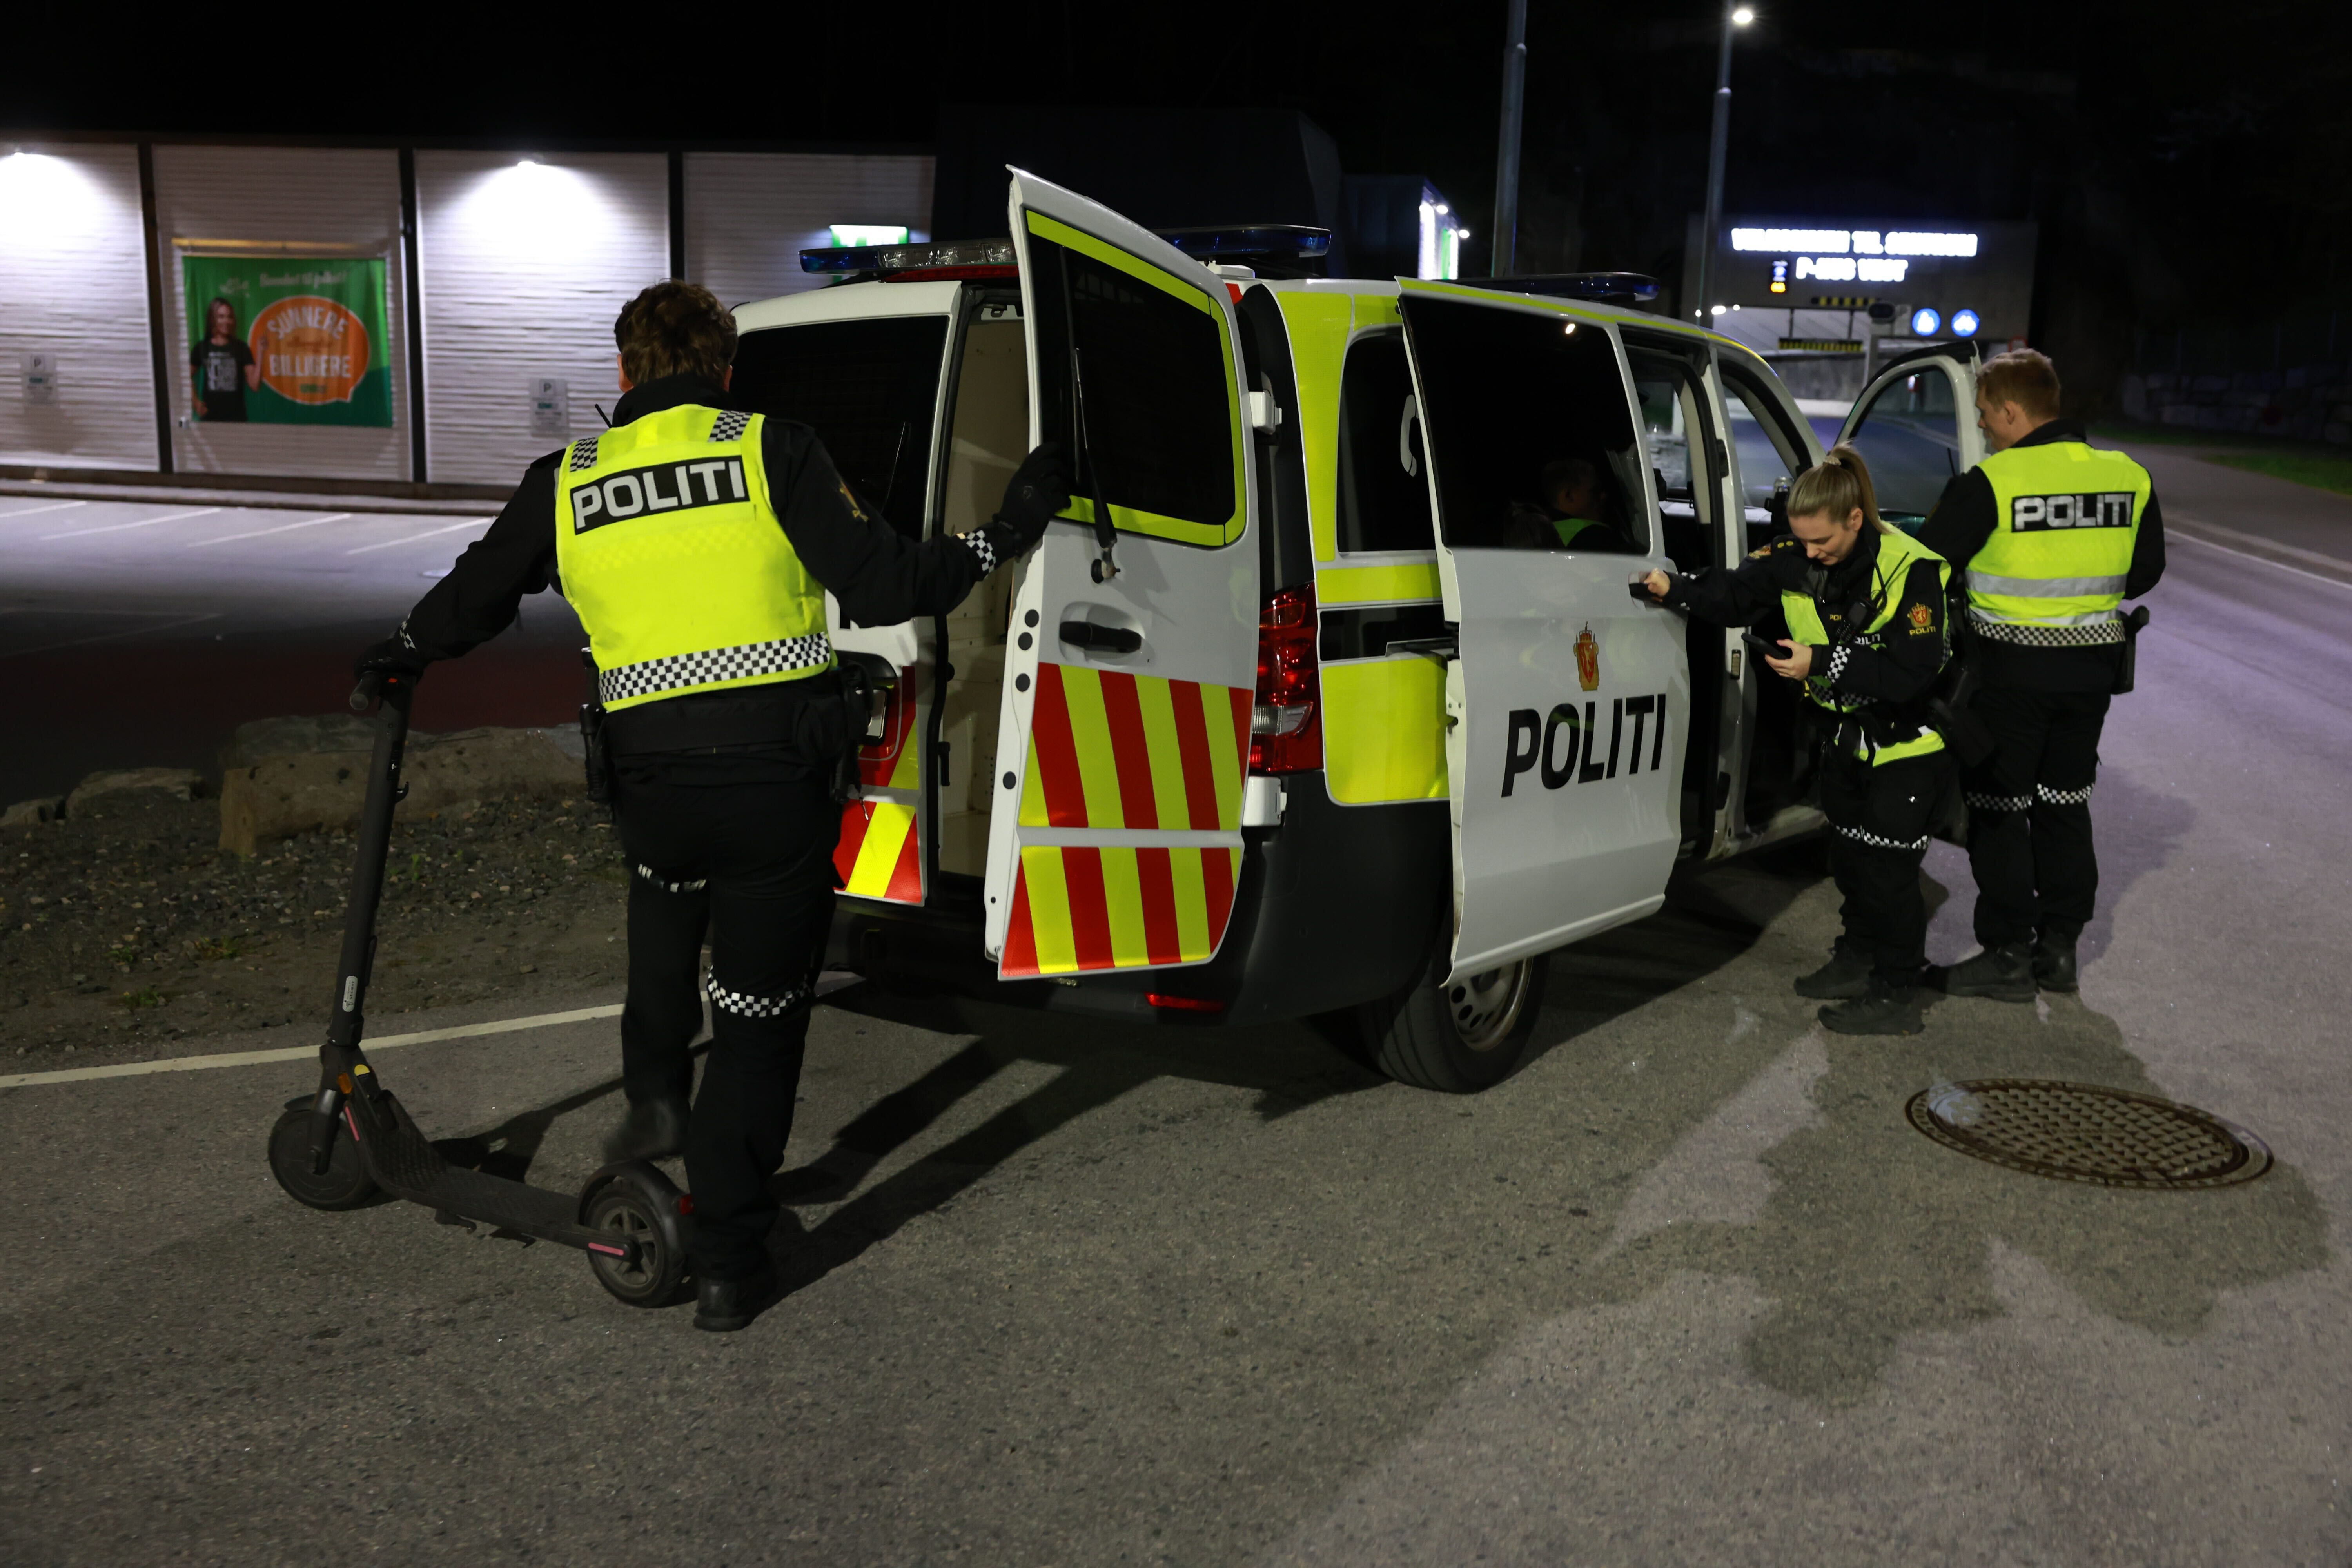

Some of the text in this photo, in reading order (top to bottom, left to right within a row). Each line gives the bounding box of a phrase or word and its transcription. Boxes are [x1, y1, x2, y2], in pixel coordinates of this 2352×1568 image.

[270, 354, 351, 378] BILLIGERE
[573, 461, 745, 529] POLITI
[2014, 494, 2132, 530] POLITI
[1909, 626, 1936, 635] POLITI
[1501, 693, 1666, 798] POLITI
